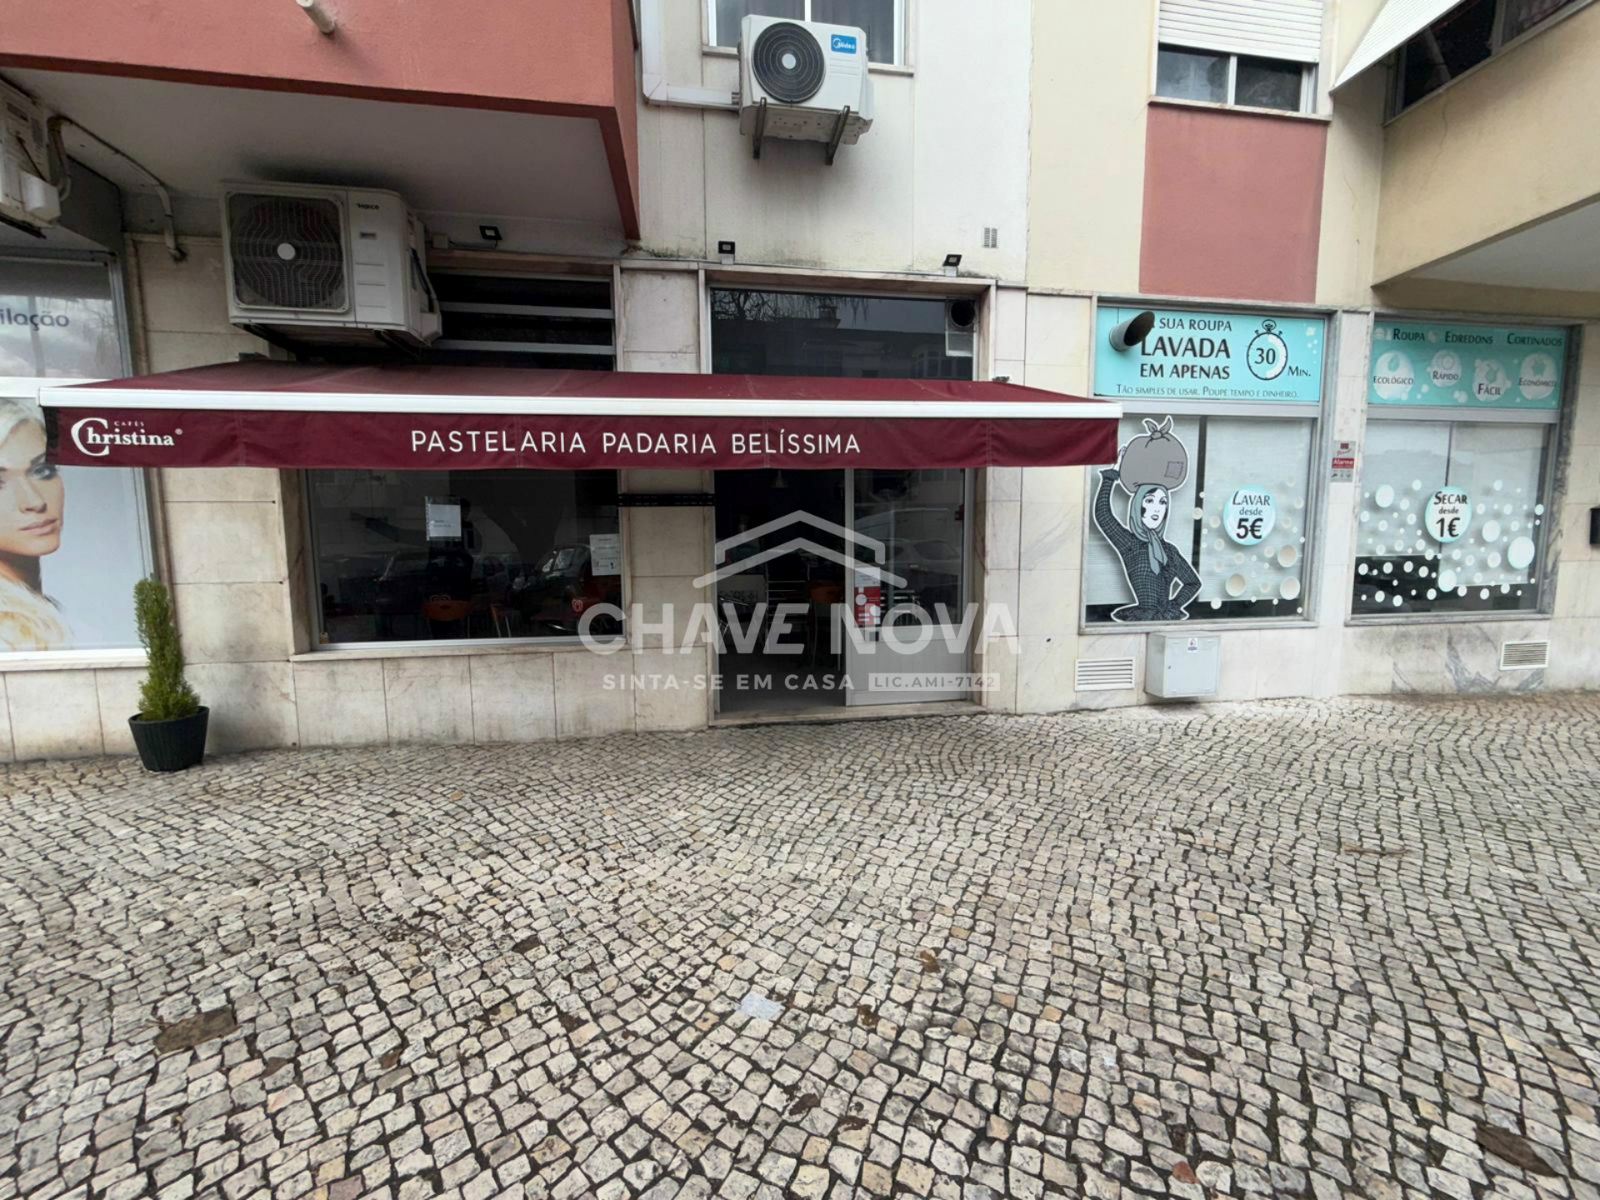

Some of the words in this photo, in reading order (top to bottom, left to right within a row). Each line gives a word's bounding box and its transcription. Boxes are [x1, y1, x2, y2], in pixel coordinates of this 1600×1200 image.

[1159, 318, 1185, 330] SUA
[1189, 319, 1232, 332] ROUPA
[1393, 328, 1425, 341] ROUPA
[1445, 331, 1493, 345] EDREDONS
[1507, 333, 1563, 346] CORTINADOS
[1140, 336, 1231, 358] LAVADA
[1254, 347, 1276, 365] 30
[1140, 364, 1164, 378] EM
[1169, 365, 1230, 380] APENAS
[1135, 387, 1165, 395] SIMPLES
[71, 417, 175, 456] Christina
[410, 429, 587, 454] PASTELARIA
[602, 431, 717, 454] PADARIA
[731, 429, 861, 455] BELÍSSIMA
[1232, 491, 1271, 507] LAVAR
[1433, 490, 1468, 505] SECAR
[1239, 507, 1263, 516] desde
[1438, 507, 1460, 515] desde
[1235, 518, 1264, 540] 5€
[1435, 517, 1461, 538] 1€
